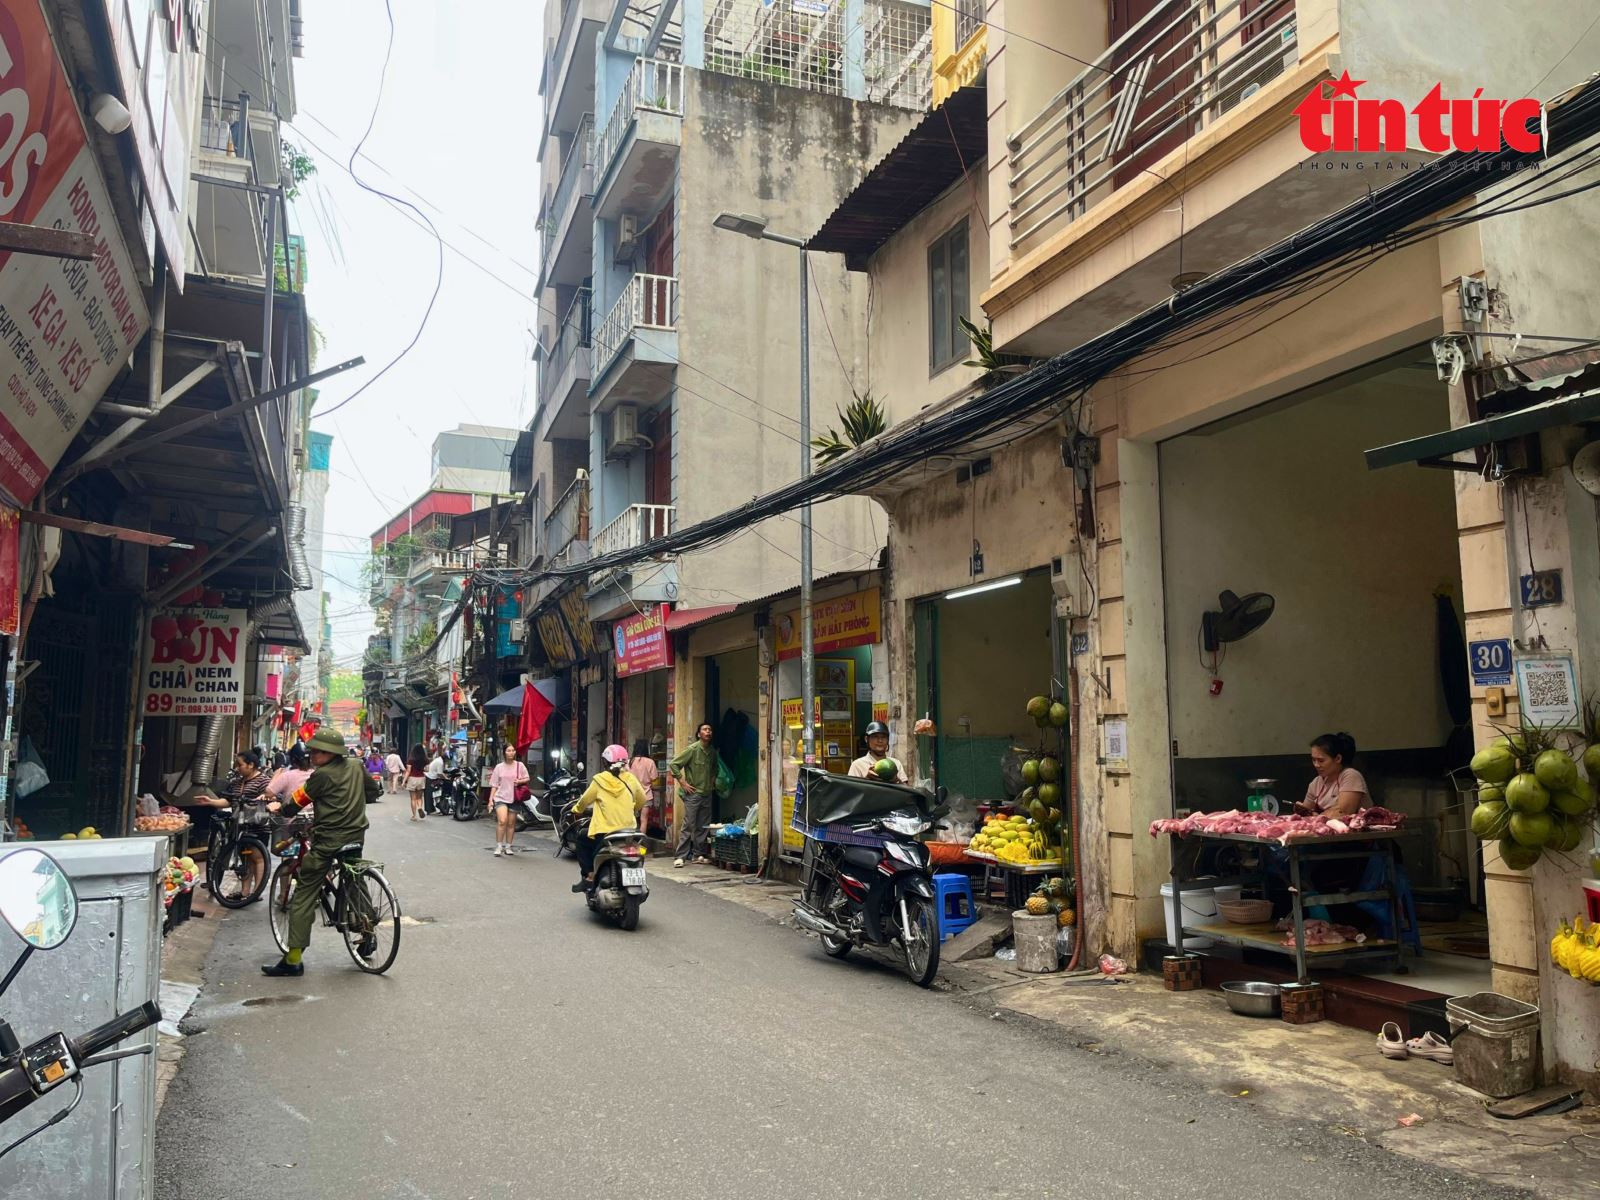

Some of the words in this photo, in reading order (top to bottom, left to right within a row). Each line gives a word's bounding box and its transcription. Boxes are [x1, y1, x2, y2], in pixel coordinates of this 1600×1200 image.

[67, 176, 101, 238] HONDA
[93, 237, 121, 300] MOTOR
[28, 283, 57, 329] XE
[42, 308, 67, 351] GA
[58, 337, 82, 376] XE
[69, 357, 100, 394] SỐ
[1526, 577, 1556, 603] 28
[844, 615, 870, 632] PHÒNG
[1477, 645, 1504, 669] 30
[149, 665, 187, 689] CHẢ
[195, 667, 232, 678] NEM
[146, 693, 173, 712] 89
[188, 705, 202, 713] 098
[219, 704, 237, 713] 1970
